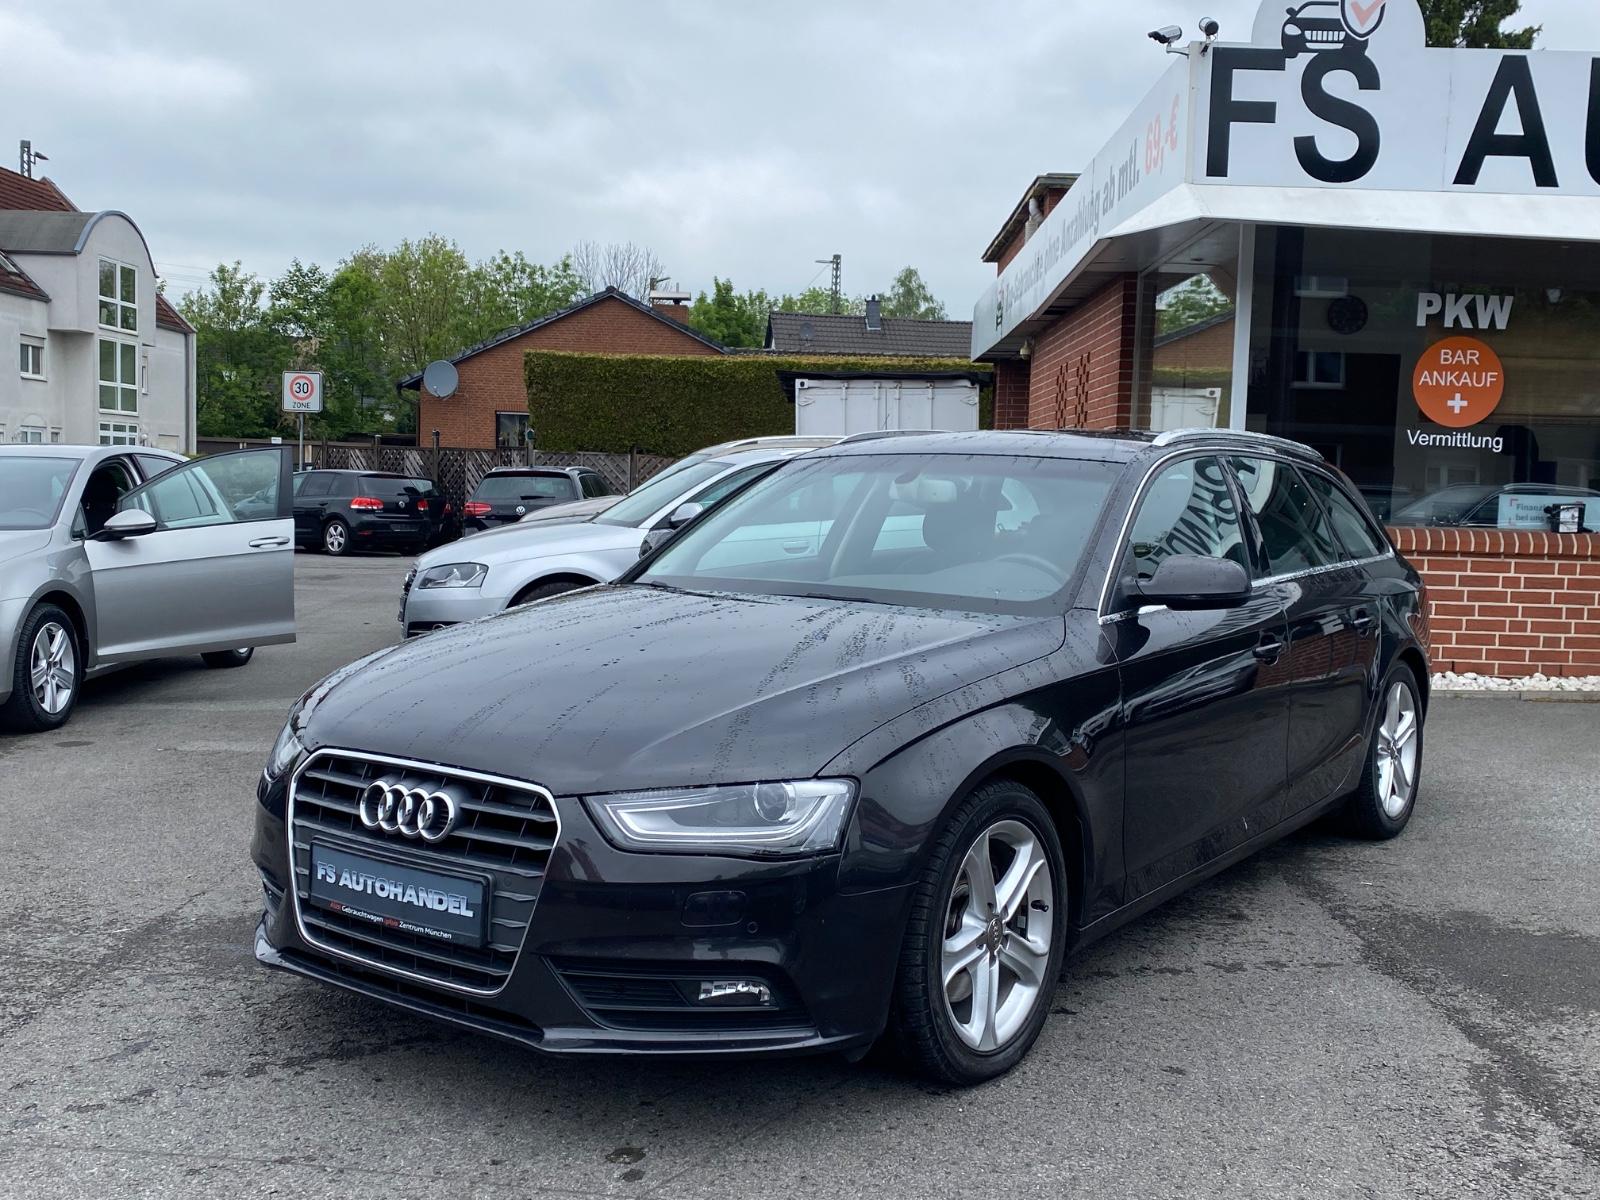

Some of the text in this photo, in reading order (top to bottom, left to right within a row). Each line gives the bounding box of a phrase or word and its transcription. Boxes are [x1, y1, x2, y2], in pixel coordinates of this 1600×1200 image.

[1206, 46, 1381, 183] FS
[1060, 193, 1100, 257] Anzahlung
[1102, 165, 1116, 216] ab
[1118, 136, 1140, 202] mtl.
[1416, 292, 1514, 330] PKW
[1440, 350, 1480, 365] BAR
[294, 382, 309, 394] 30
[1418, 370, 1498, 387] ANKAUF
[1407, 429, 1503, 453] Vermittlung
[316, 861, 474, 917] FS AUTOHANDEL
[341, 905, 384, 922] Gebrauchtwagen
[399, 921, 424, 933] Zentrum
[424, 927, 452, 940] München
